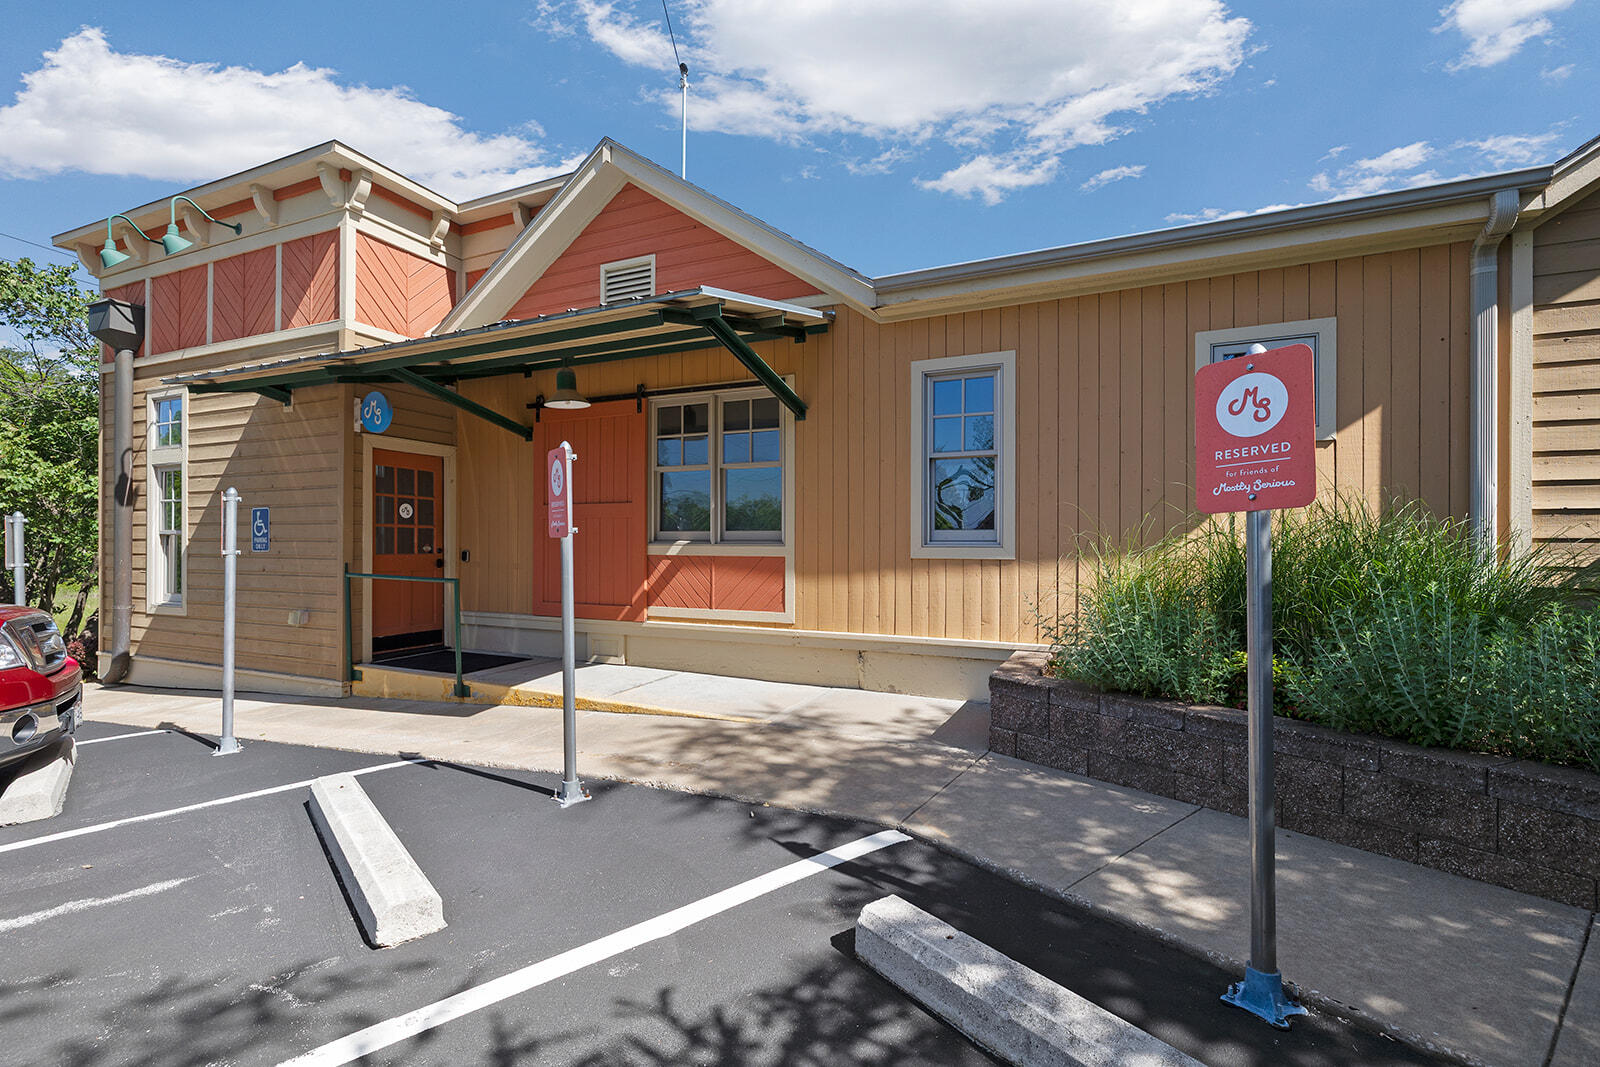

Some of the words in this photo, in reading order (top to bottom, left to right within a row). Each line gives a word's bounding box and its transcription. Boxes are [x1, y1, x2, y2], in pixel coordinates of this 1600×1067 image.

[1215, 441, 1291, 460] RESERVED
[1271, 464, 1280, 472] of
[1212, 481, 1251, 495] Mostly
[1253, 479, 1296, 491] Serious
